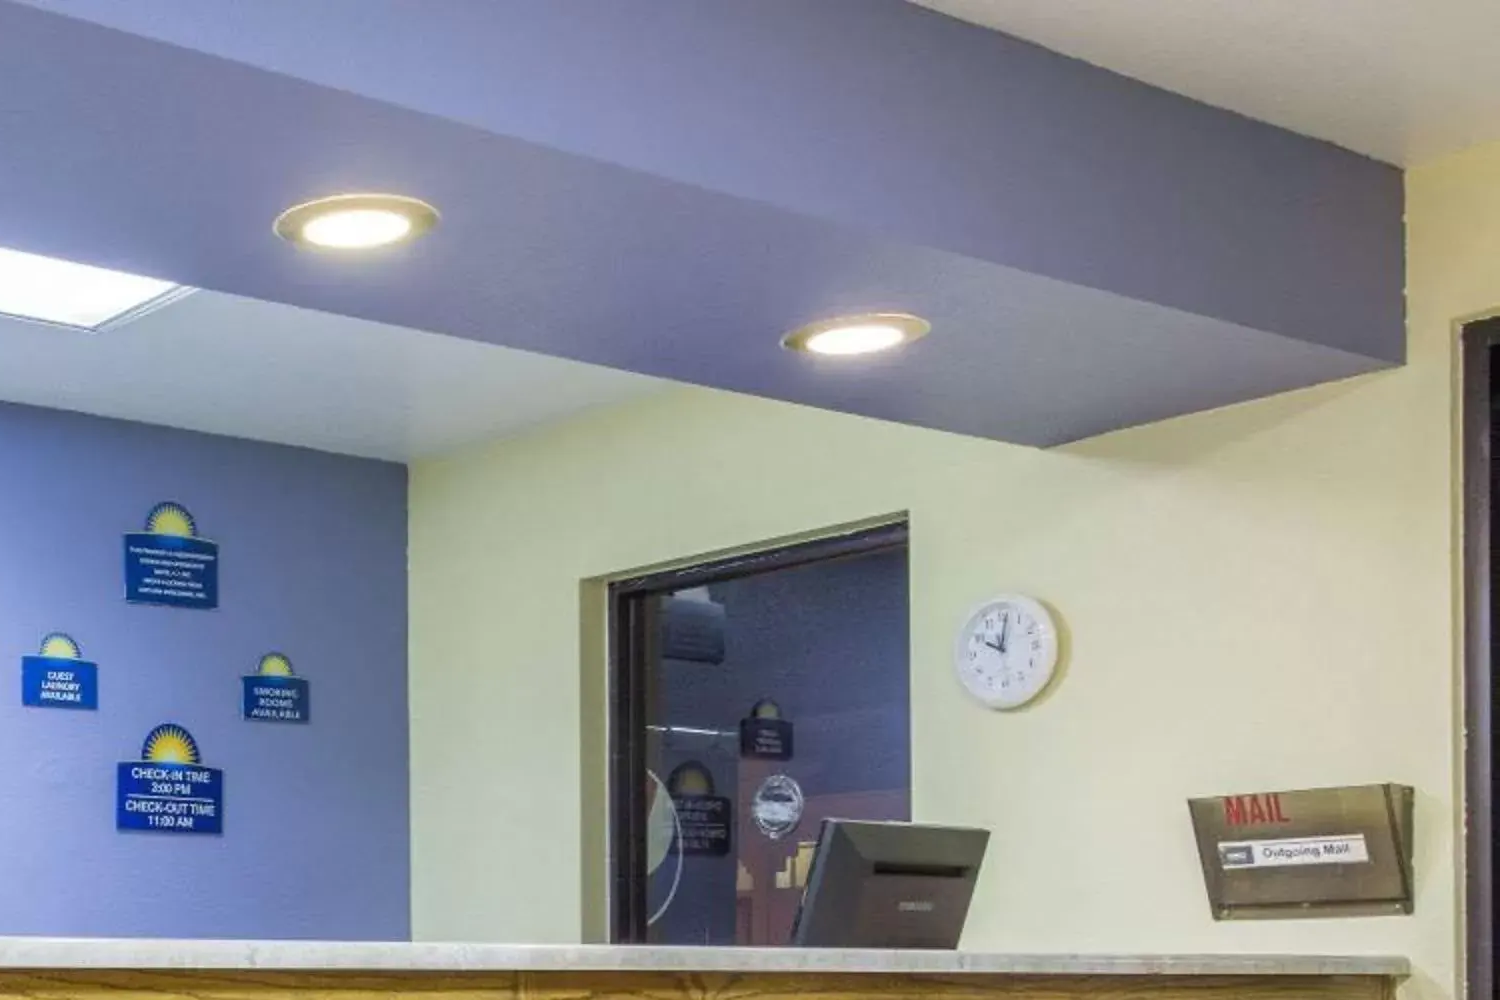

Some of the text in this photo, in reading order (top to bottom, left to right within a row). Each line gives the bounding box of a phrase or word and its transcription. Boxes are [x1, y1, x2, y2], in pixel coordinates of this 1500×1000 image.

[131, 767, 211, 783] CHECK-IN TIME
[174, 783, 191, 795] PM
[125, 799, 216, 817] CHECK-OUT TIME
[1224, 793, 1291, 825] MAIL
[148, 815, 193, 828] 11:00 AM
[1262, 843, 1350, 858] Outgoing Mail
